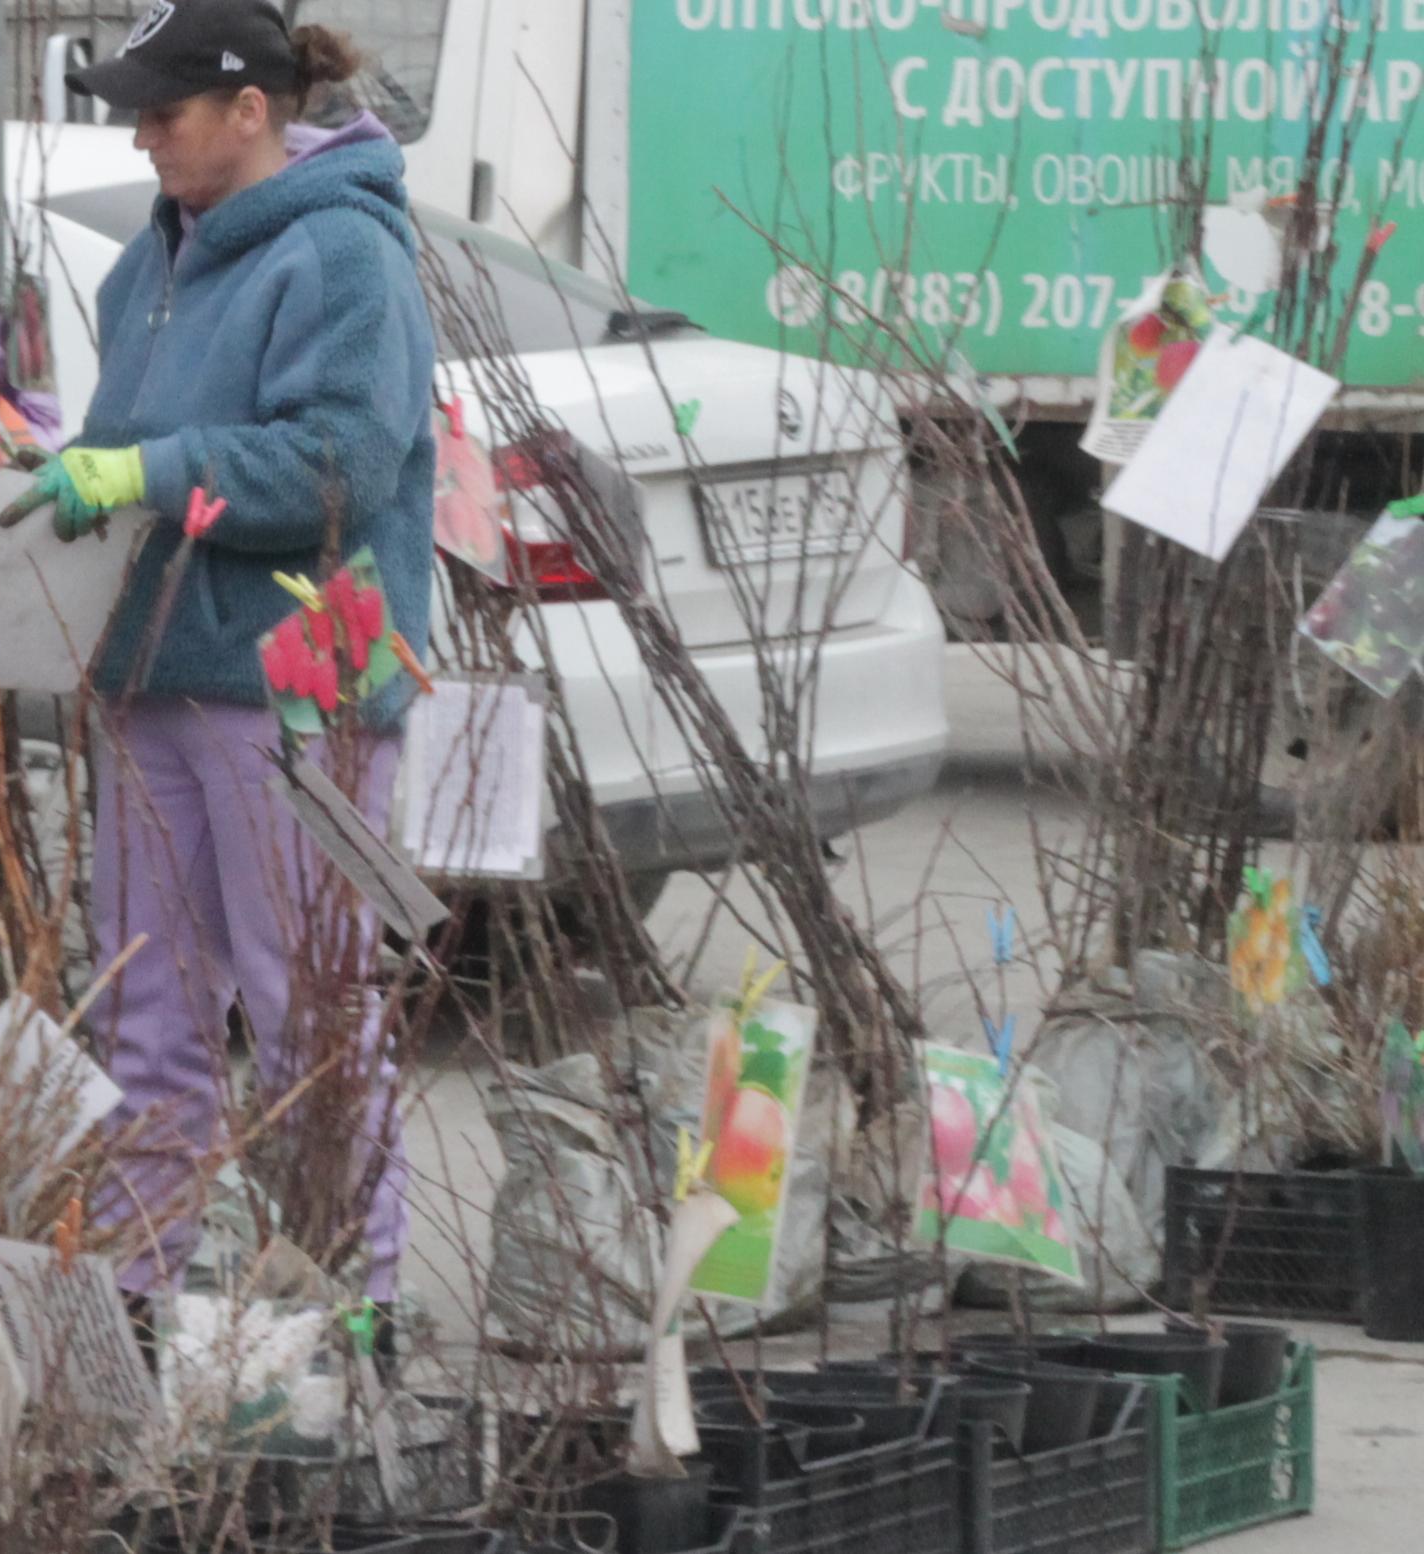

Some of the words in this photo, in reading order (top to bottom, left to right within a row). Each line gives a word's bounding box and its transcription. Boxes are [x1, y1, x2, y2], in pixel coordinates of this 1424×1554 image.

[892, 57, 928, 119] С
[942, 42, 1322, 127] ДОСТУПНОЙ
[832, 152, 1019, 212] ФРУКТЫ,
[1226, 155, 1361, 214] МЯО,
